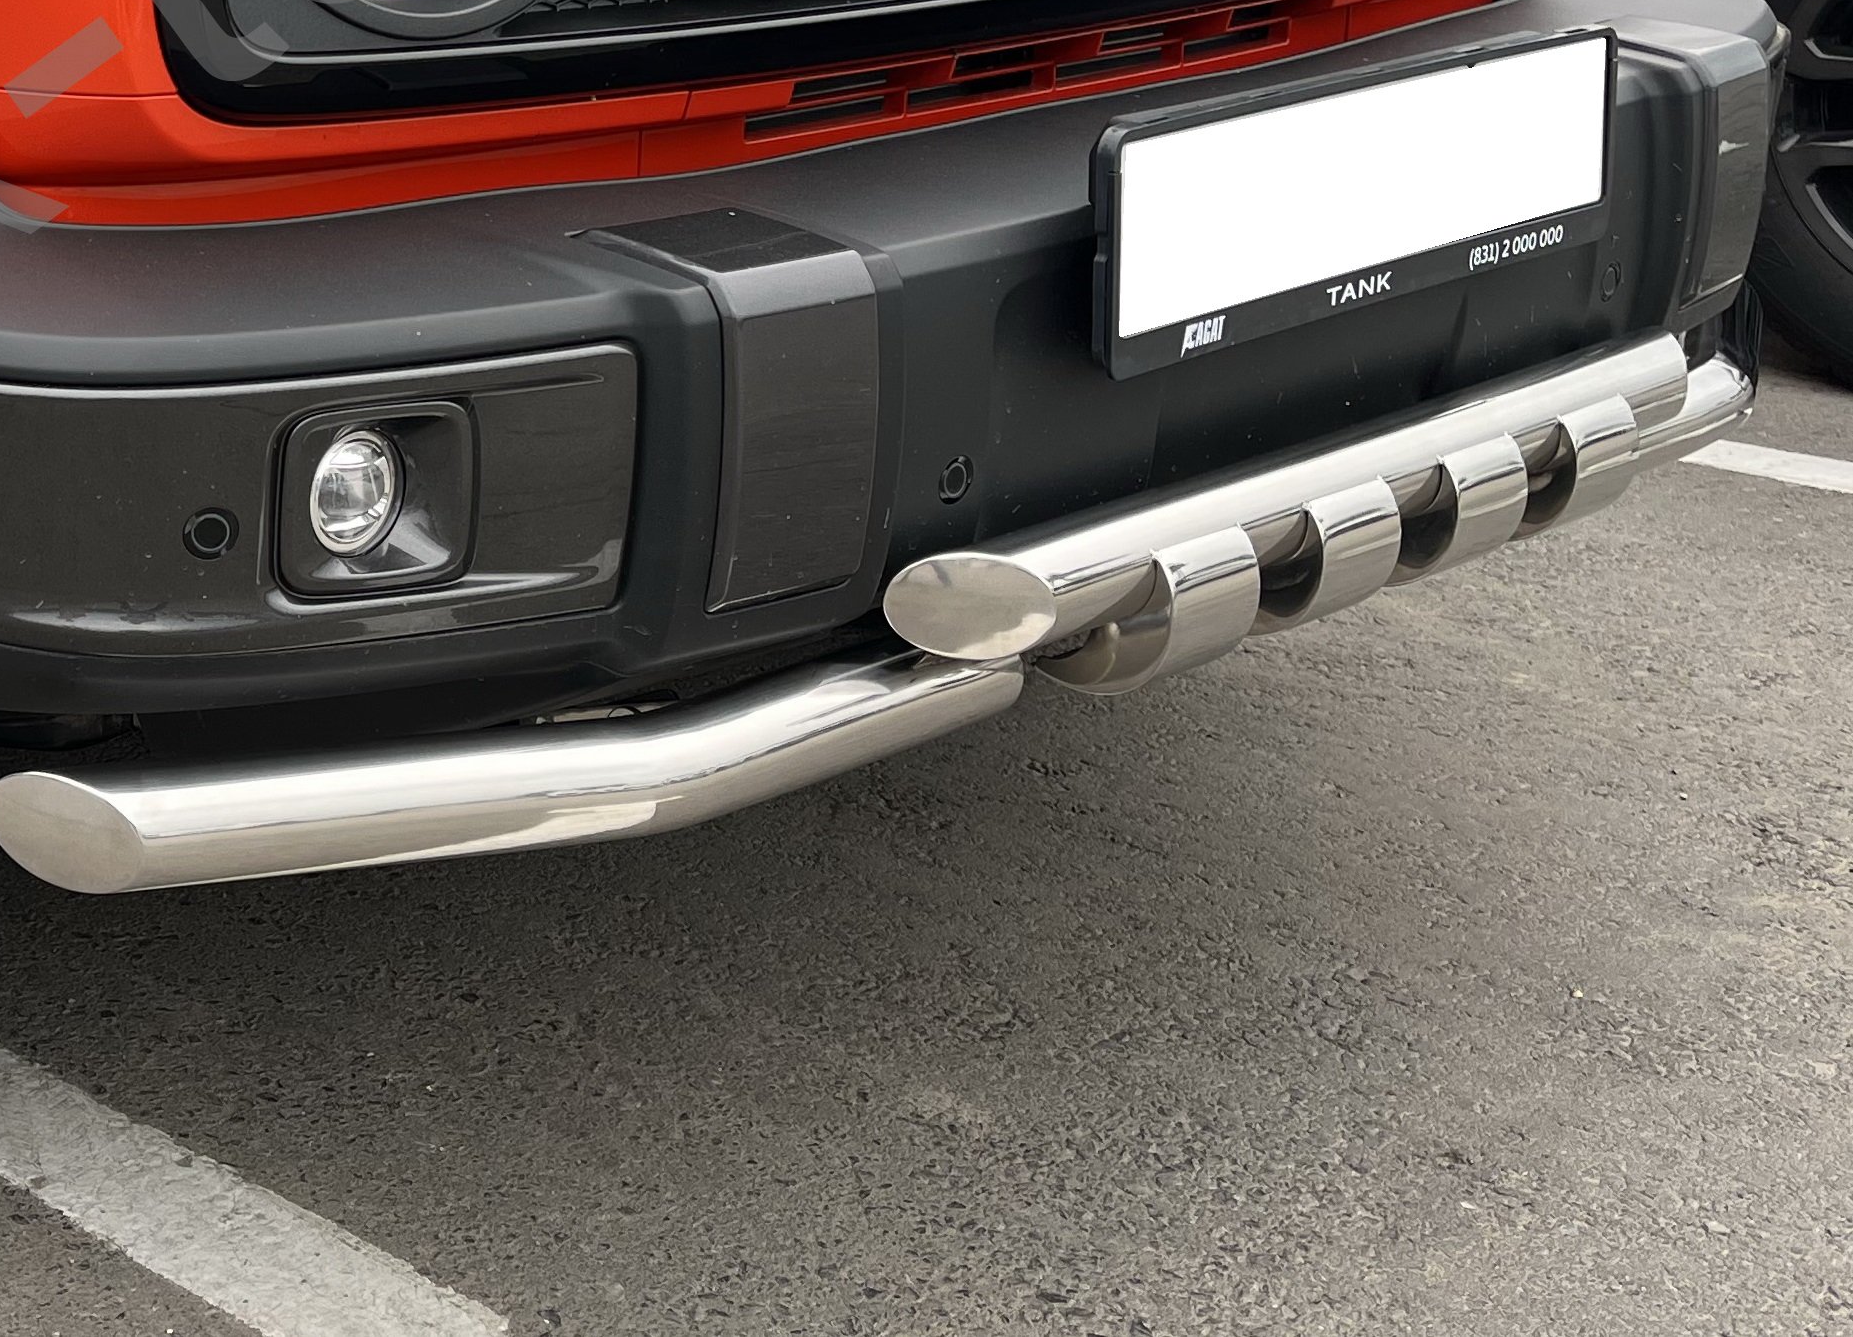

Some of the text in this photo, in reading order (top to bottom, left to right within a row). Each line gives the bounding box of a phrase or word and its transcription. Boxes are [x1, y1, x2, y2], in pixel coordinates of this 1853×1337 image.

[1469, 224, 1564, 271] (831) 2 000 000
[1326, 271, 1393, 306] TANK
